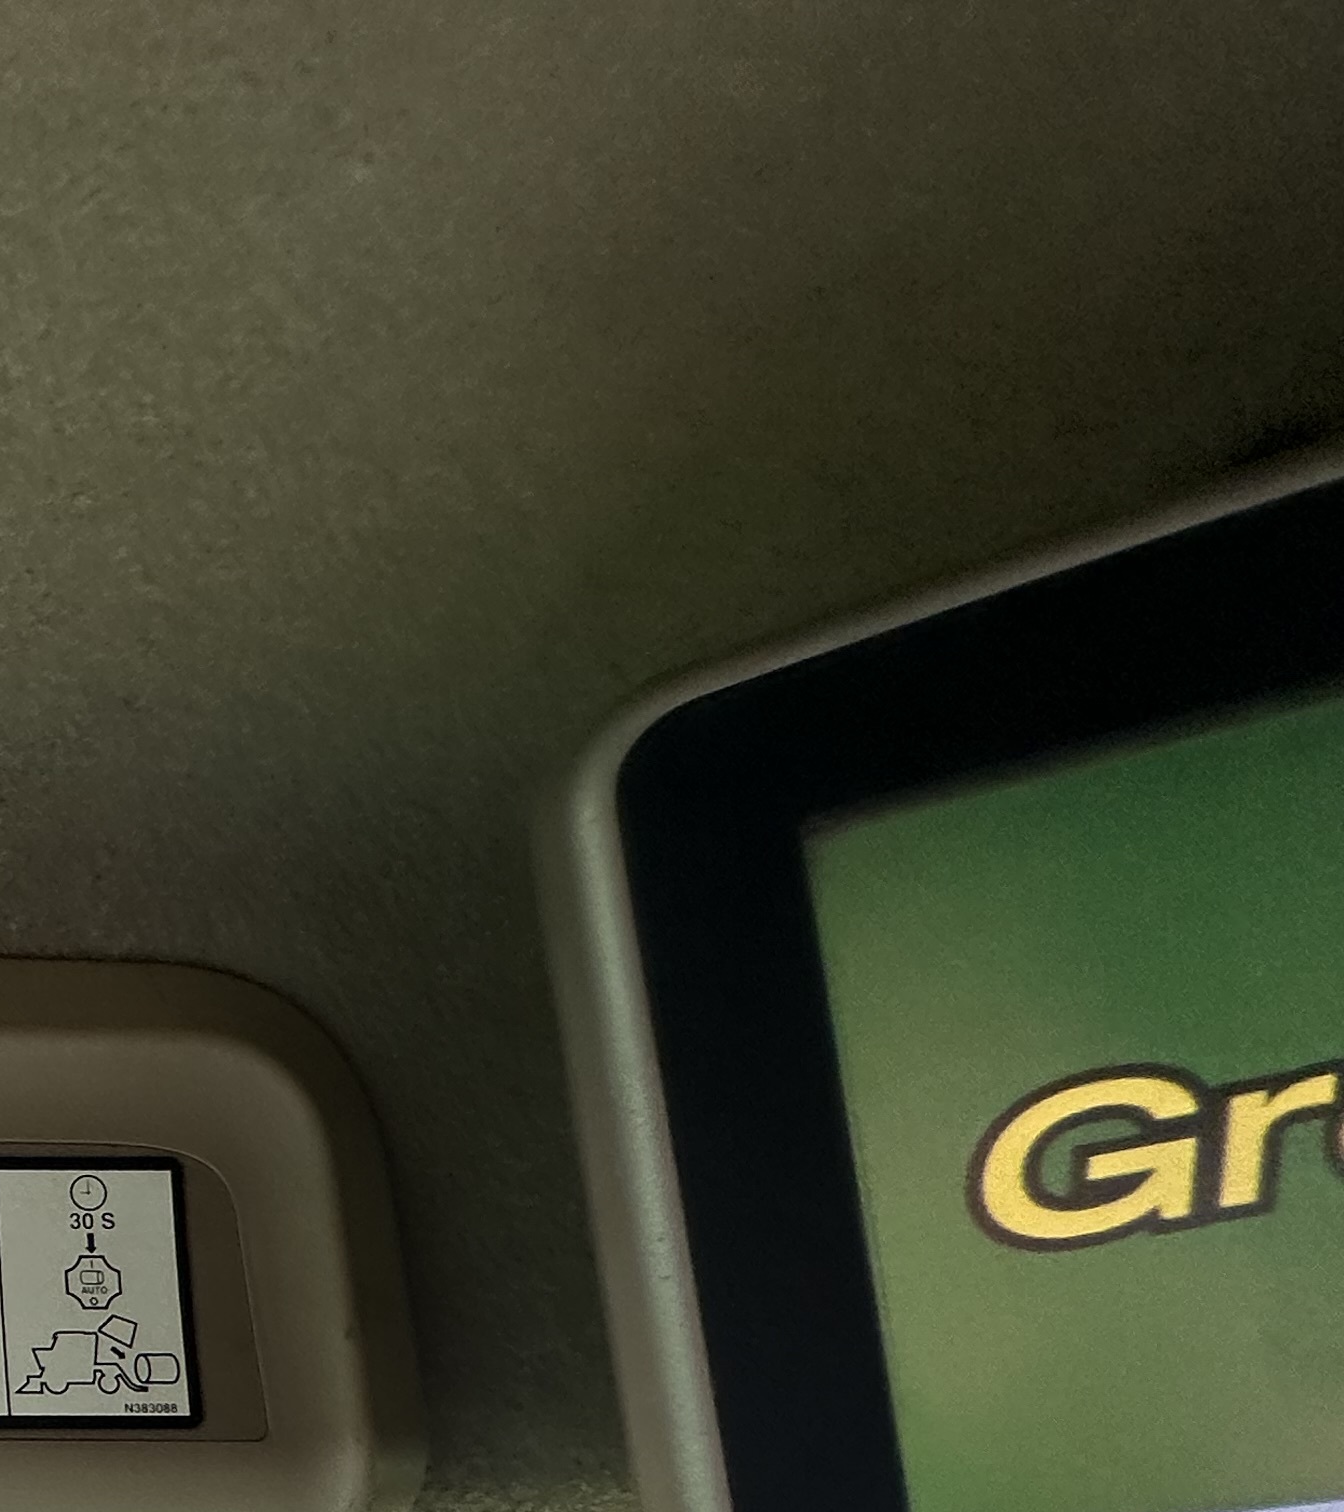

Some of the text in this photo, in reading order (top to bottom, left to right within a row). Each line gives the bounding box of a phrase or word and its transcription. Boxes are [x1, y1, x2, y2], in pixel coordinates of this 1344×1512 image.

[974, 1066, 1344, 1245] Gr
[70, 1212, 115, 1230] 30 S
[81, 1286, 108, 1295] AUTO
